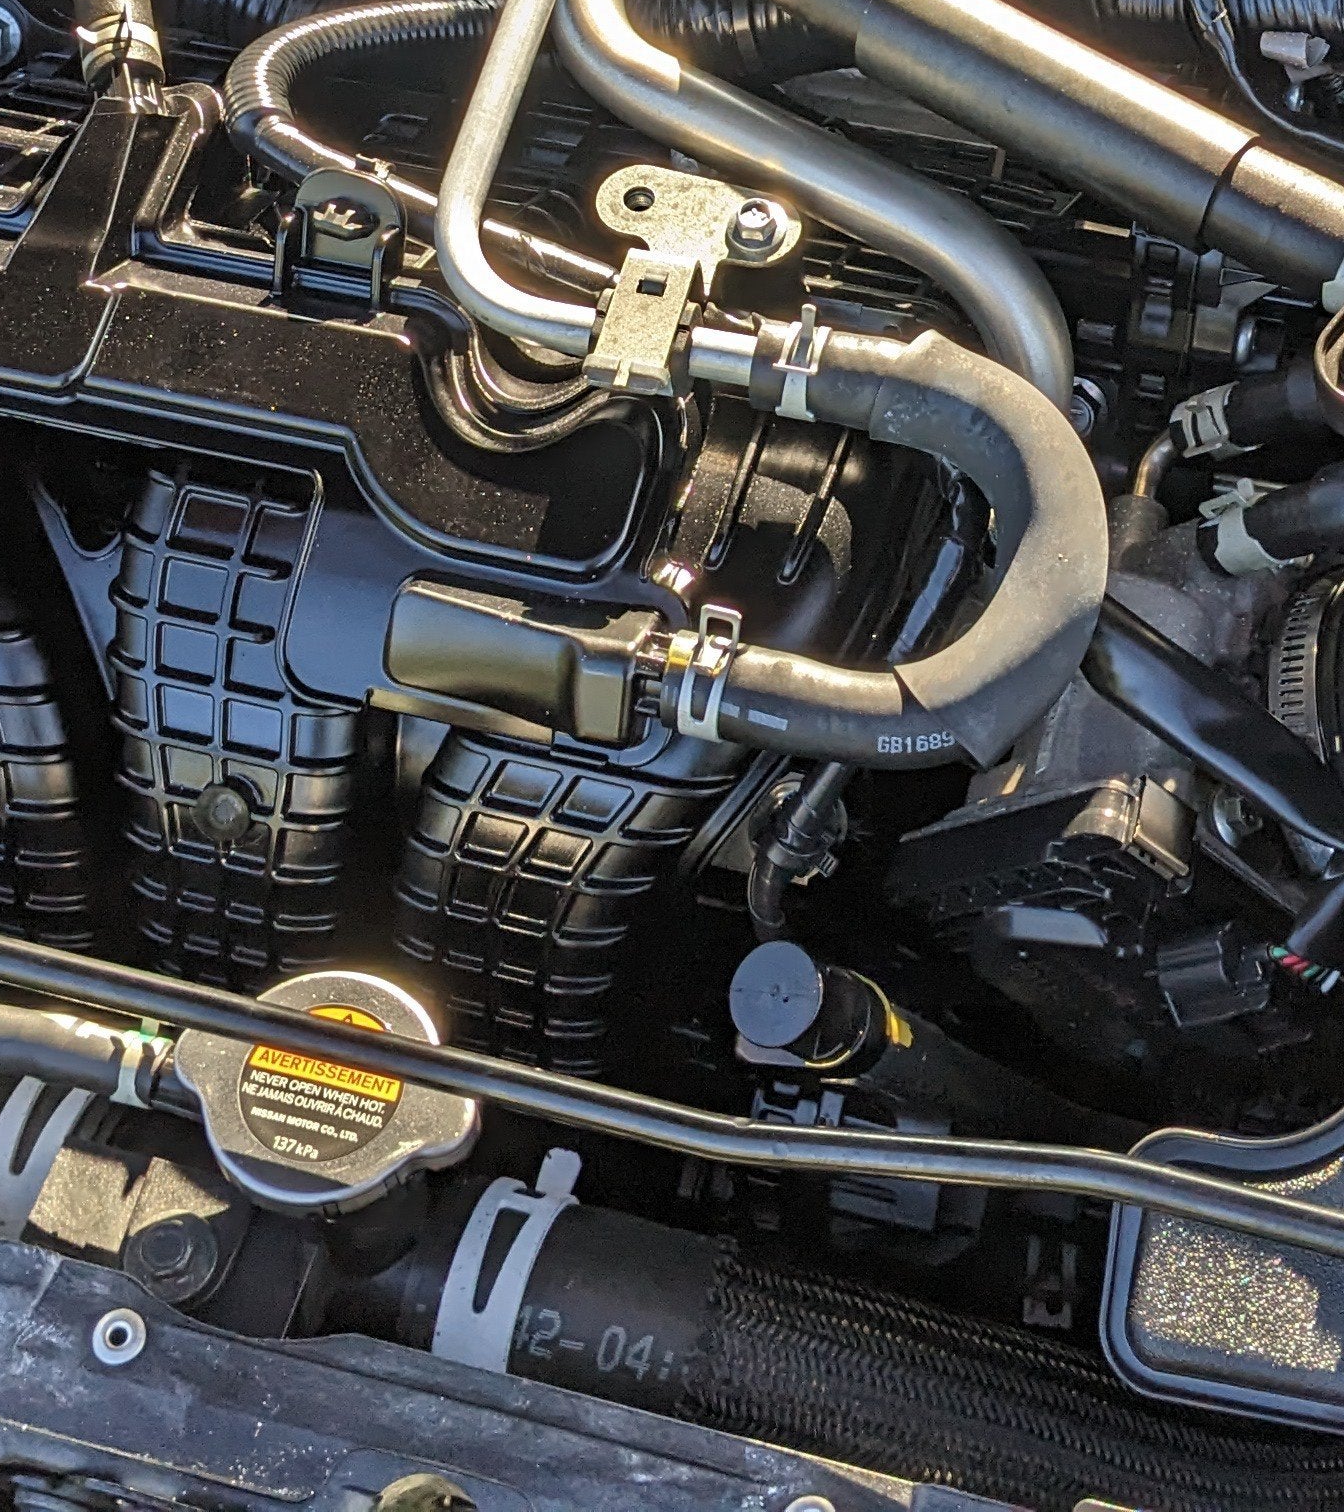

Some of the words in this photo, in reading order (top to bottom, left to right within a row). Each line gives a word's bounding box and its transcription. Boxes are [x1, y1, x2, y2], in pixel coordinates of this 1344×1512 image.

[259, 1049, 396, 1094] AVERTISSEMENT
[241, 1082, 259, 1097] NE
[257, 1085, 294, 1105] JAMAIS
[294, 1093, 337, 1116] OUVRIR
[250, 1069, 289, 1089] NEVER
[289, 1079, 322, 1096] OPEN
[323, 1088, 357, 1107] WHEN
[359, 1097, 386, 1115] HOT.
[286, 1114, 320, 1133] MOTOR
[273, 1135, 297, 1152] 137
[295, 1142, 320, 1161] kPa
